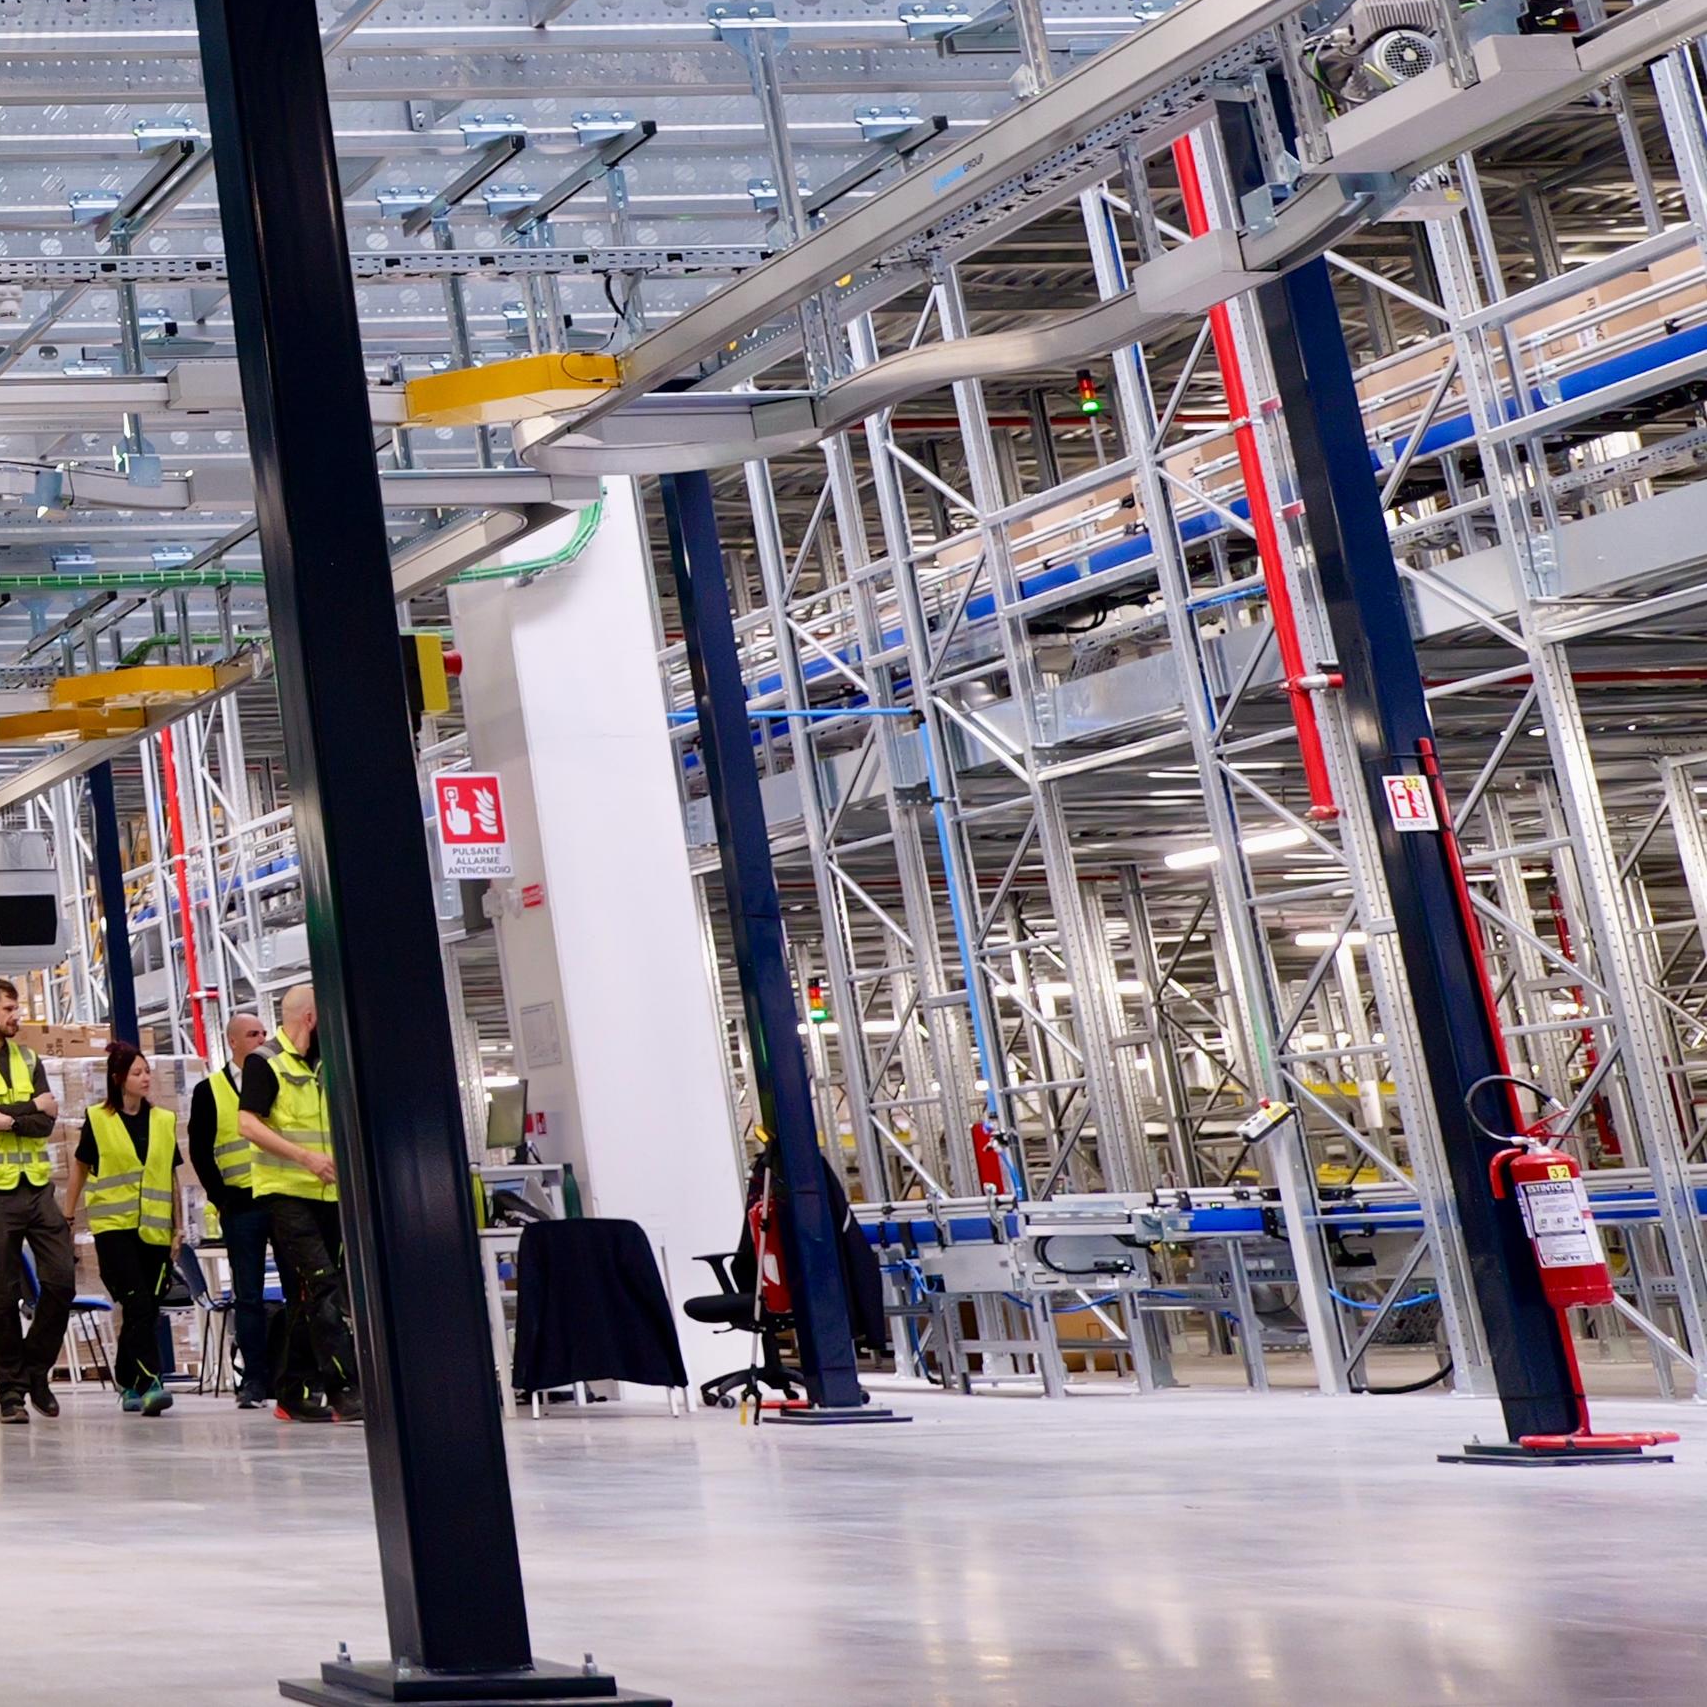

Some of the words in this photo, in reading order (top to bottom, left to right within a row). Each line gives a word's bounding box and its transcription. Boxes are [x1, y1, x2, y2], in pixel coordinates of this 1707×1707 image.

[452, 846, 502, 855] PULSANTE
[456, 856, 500, 865] ALLARME
[448, 865, 512, 875] ANTINCENDIO
